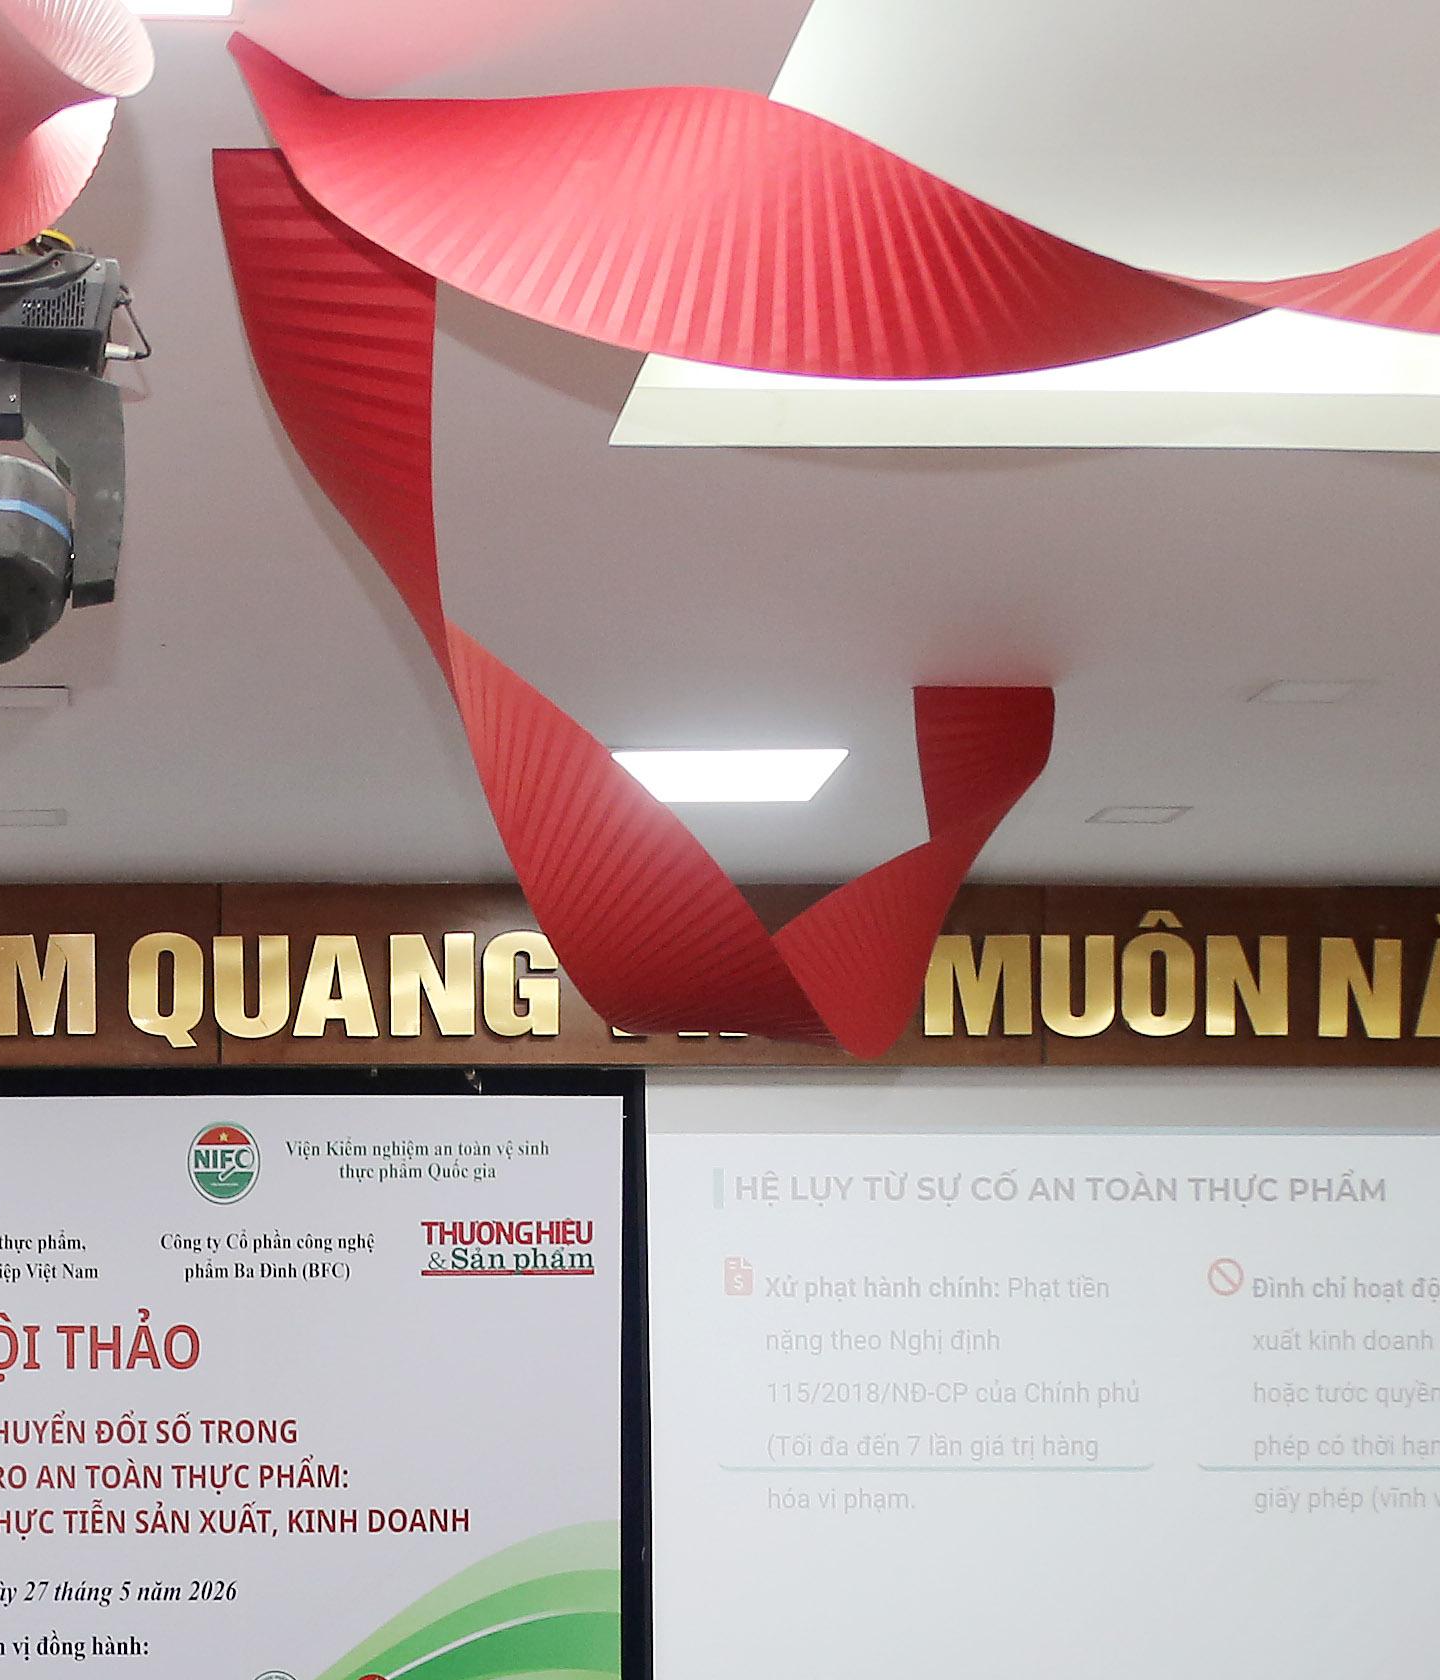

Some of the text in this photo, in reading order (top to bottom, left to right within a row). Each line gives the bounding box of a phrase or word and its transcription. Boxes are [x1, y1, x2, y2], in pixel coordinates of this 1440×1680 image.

[128, 931, 560, 1049] QUANG
[924, 910, 1289, 1037] MUÔN
[286, 1140, 548, 1160] Viện Kiểm nghiệm an toàn vệ sinh
[340, 1163, 495, 1182] thực phẩm Quốc gia
[736, 1169, 1386, 1208] HỆ LỤY TỪ SỰ CỐ AN TOÀN THỰC PHẨM
[451, 1246, 507, 1270] Sản
[513, 1246, 595, 1275] phẩm
[57, 1308, 199, 1369] THẢO
[766, 1328, 1000, 1356] nặng theo Nghị định
[95, 1412, 147, 1444] ĐỔI
[156, 1412, 191, 1443] SỐ
[200, 1420, 296, 1443] TRONG
[36, 1465, 75, 1488] AN
[85, 1458, 161, 1489] TOÀN
[171, 1464, 249, 1495] THỰC
[260, 1456, 348, 1488] PHẨM:
[63, 1501, 125, 1534] TIỄN
[136, 1501, 189, 1533] SẢN
[199, 1501, 277, 1537] XUẤT,
[289, 1510, 357, 1533] KINH
[369, 1509, 468, 1532] DOANH
[24, 1581, 49, 1601] 27
[54, 1581, 112, 1607] tháng
[120, 1581, 131, 1601] 5
[138, 1581, 181, 1601] năm
[188, 1581, 236, 1600] 2026
[13, 1636, 29, 1660] vị
[37, 1633, 85, 1660] đồng
[92, 1636, 148, 1655] hành:
